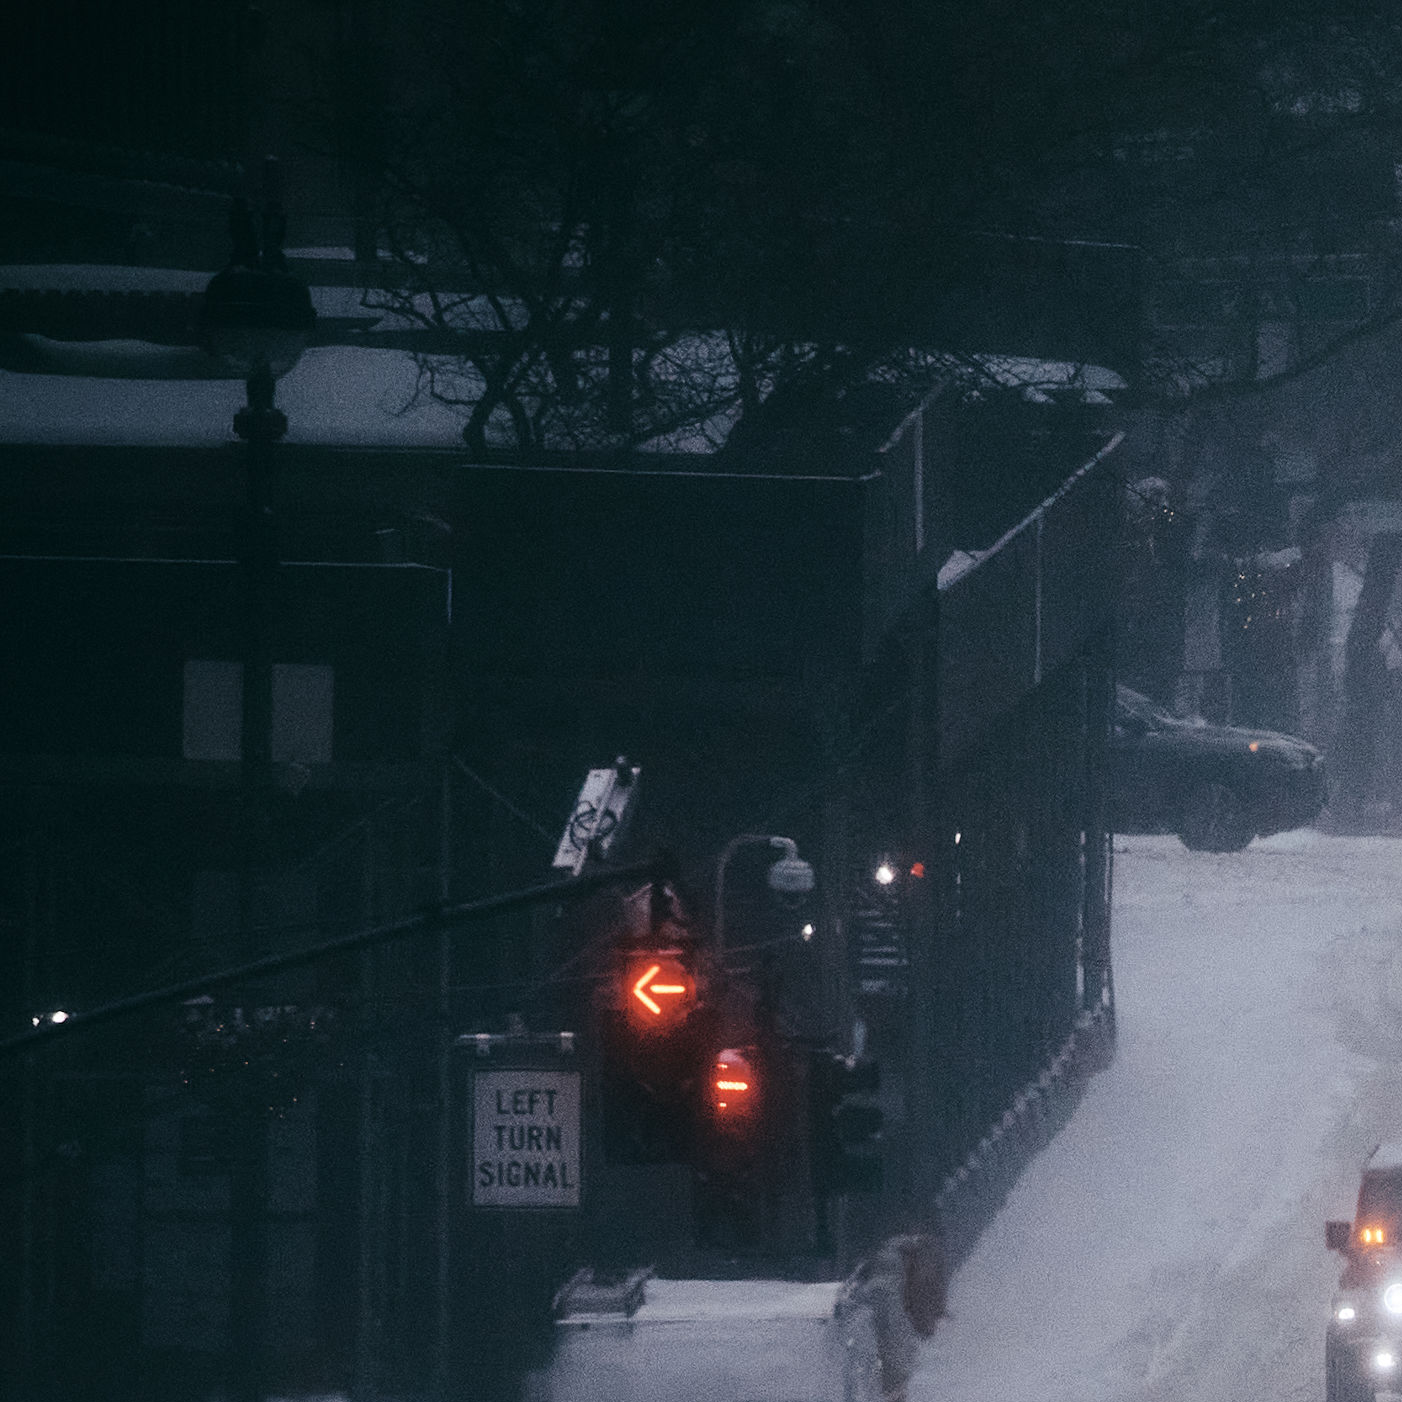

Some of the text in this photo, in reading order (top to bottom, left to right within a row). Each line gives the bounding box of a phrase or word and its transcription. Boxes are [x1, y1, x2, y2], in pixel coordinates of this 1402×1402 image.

[496, 1088, 558, 1117] LEFT
[494, 1124, 562, 1153] TURN
[479, 1160, 574, 1190] SIGNAL
